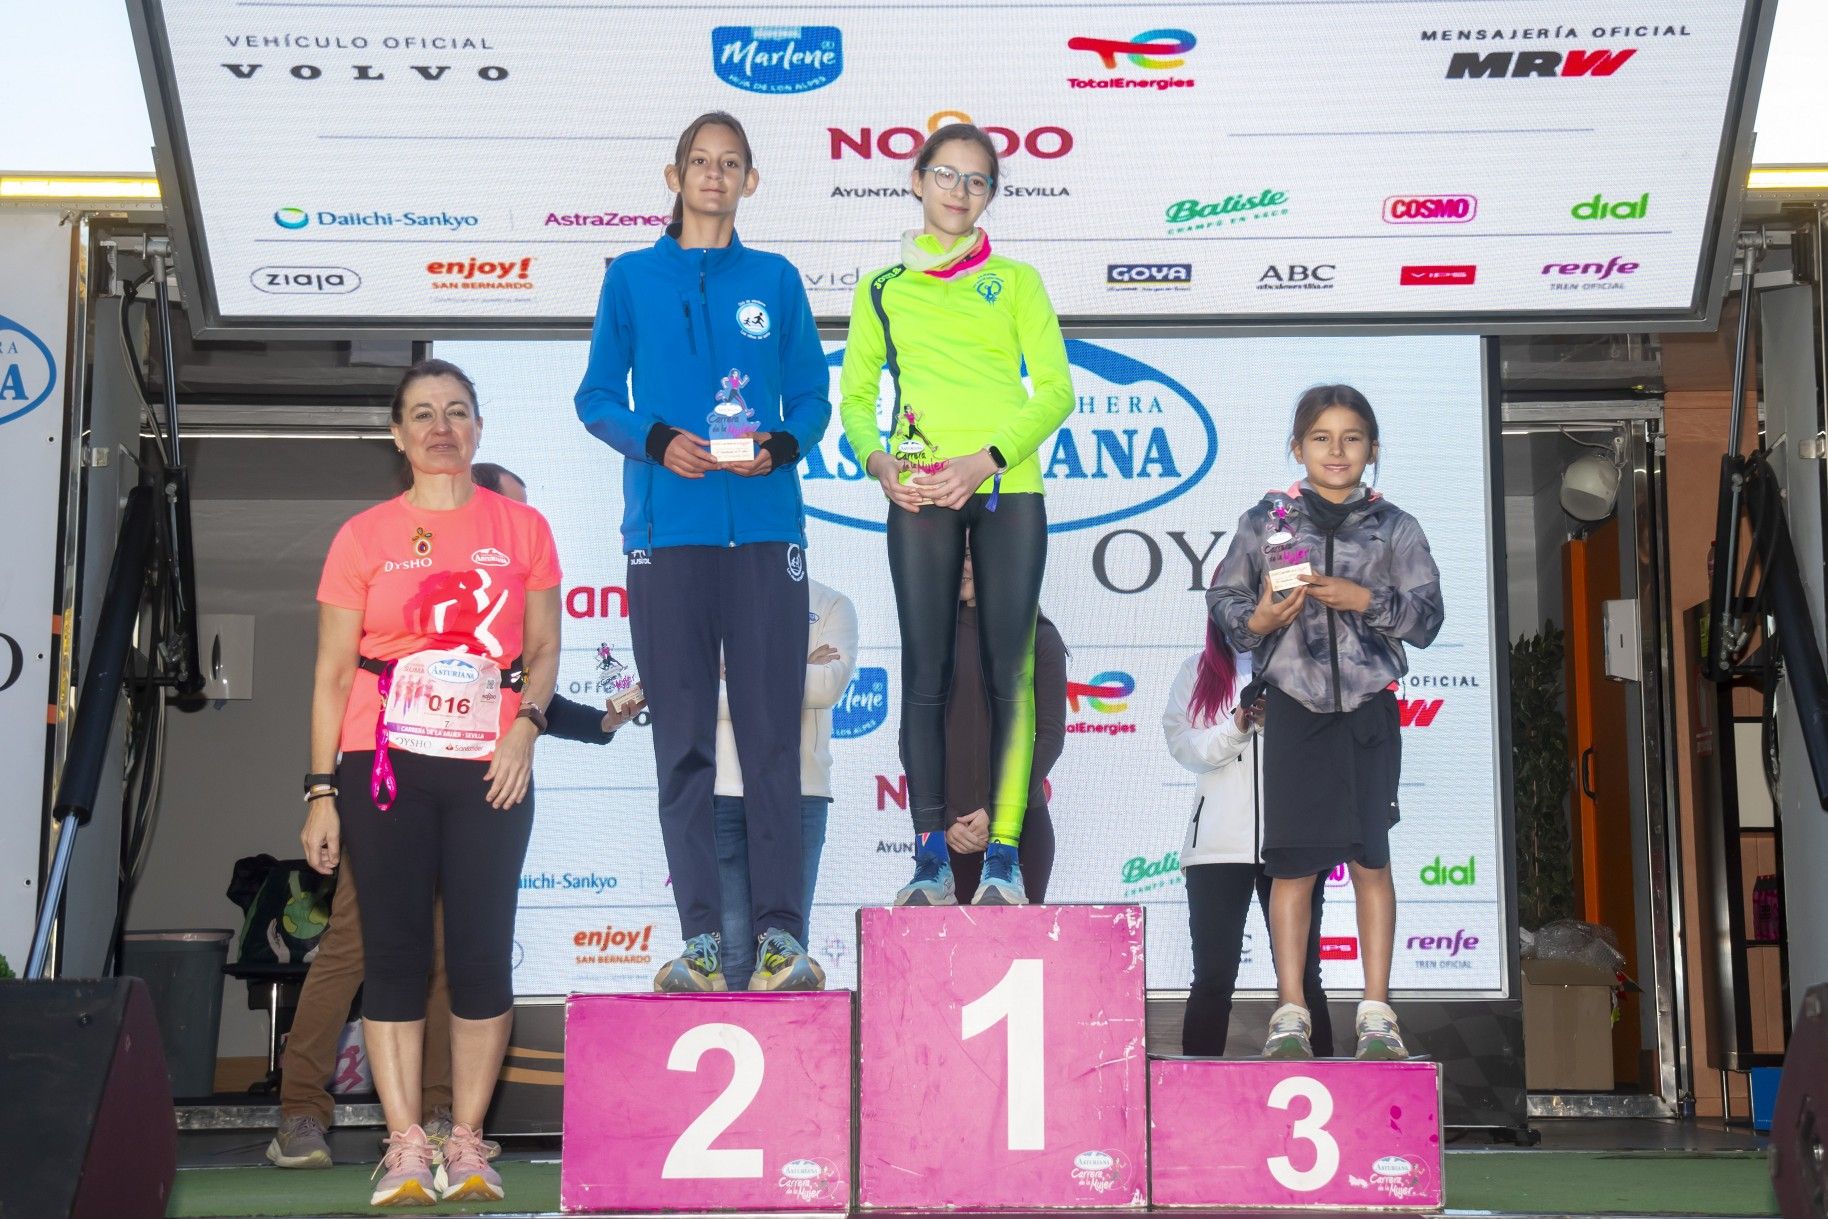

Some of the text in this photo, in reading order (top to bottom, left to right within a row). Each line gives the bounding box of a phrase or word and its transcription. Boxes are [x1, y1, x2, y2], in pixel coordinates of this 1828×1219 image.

[224, 33, 493, 49] VEHÍCULO OFICIAL
[1421, 25, 1690, 41] MENSAJERÍA OFICIAL
[720, 40, 836, 77] Marlene
[1445, 48, 1638, 79] MRW
[220, 63, 509, 81] VOLVO
[1067, 77, 1195, 91] TotalEnergies
[1003, 184, 1070, 196] SEVILLA
[1165, 187, 1289, 224] Batiste
[1390, 198, 1470, 219] COSMO
[1571, 192, 1650, 220] dial
[317, 211, 479, 230] Daiichi-Sankyo
[544, 212, 672, 227] AstraZenec
[426, 257, 532, 280] enjoy!
[1111, 266, 1187, 282] GOYA
[1259, 264, 1337, 282] ABC
[1541, 255, 1640, 280] renfe
[432, 281, 534, 290] SAN BERNARDO
[1078, 396, 1164, 414] HERA
[1410, 676, 1479, 687] OFICIAL
[428, 694, 471, 715] 016
[444, 720, 450, 728] 7
[1066, 721, 1137, 736] alEnergies
[1420, 854, 1475, 886] dial
[573, 925, 653, 952] enjoy!
[1406, 928, 1480, 957] renfe
[576, 955, 651, 964] SAN BERNARDO
[1415, 960, 1472, 969] TREN OFICIAL
[961, 959, 1046, 1151] 1
[661, 1023, 765, 1179] 2
[1267, 1077, 1340, 1193] 3
